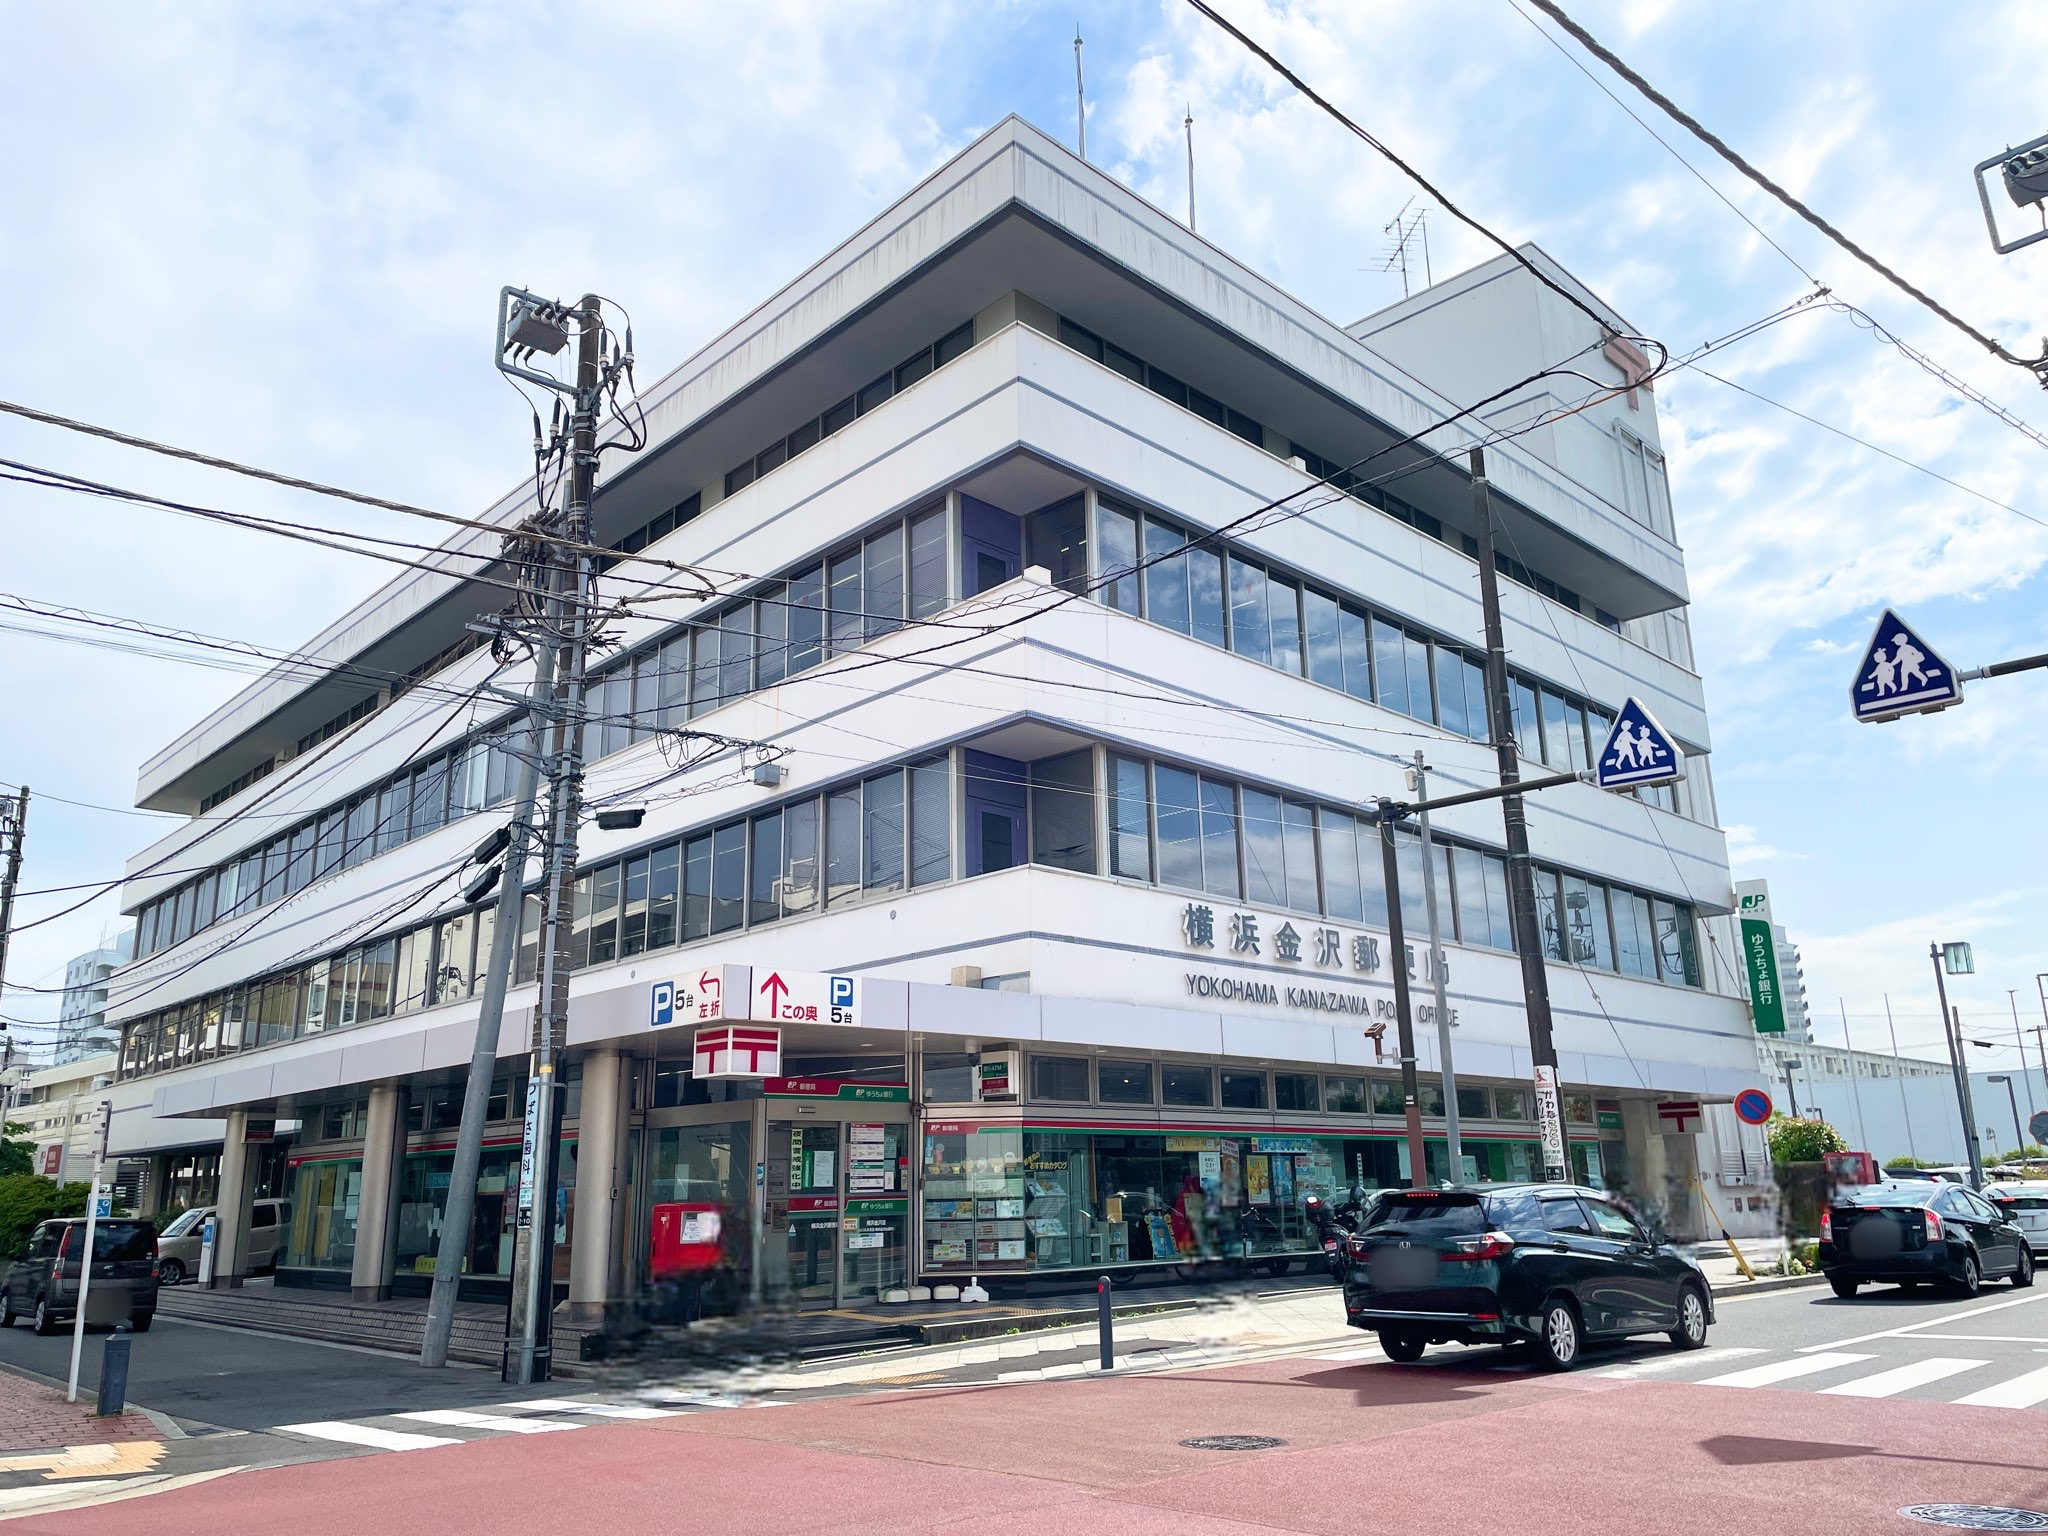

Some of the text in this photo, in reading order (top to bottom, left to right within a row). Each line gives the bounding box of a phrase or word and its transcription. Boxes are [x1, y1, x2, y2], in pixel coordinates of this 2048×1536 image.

[1751, 933, 1773, 1004] ゆうちょ銀行
[1185, 974, 1279, 1006] YOKOHAMA
[1286, 987, 1371, 1017] KANAZAWA
[1376, 999, 1399, 1020] PO
[699, 1000, 720, 1018] 左折
[782, 1005, 817, 1021] この奥
[831, 1007, 852, 1023] 5台
[866, 1090, 893, 1098] ゆうちょ銀行
